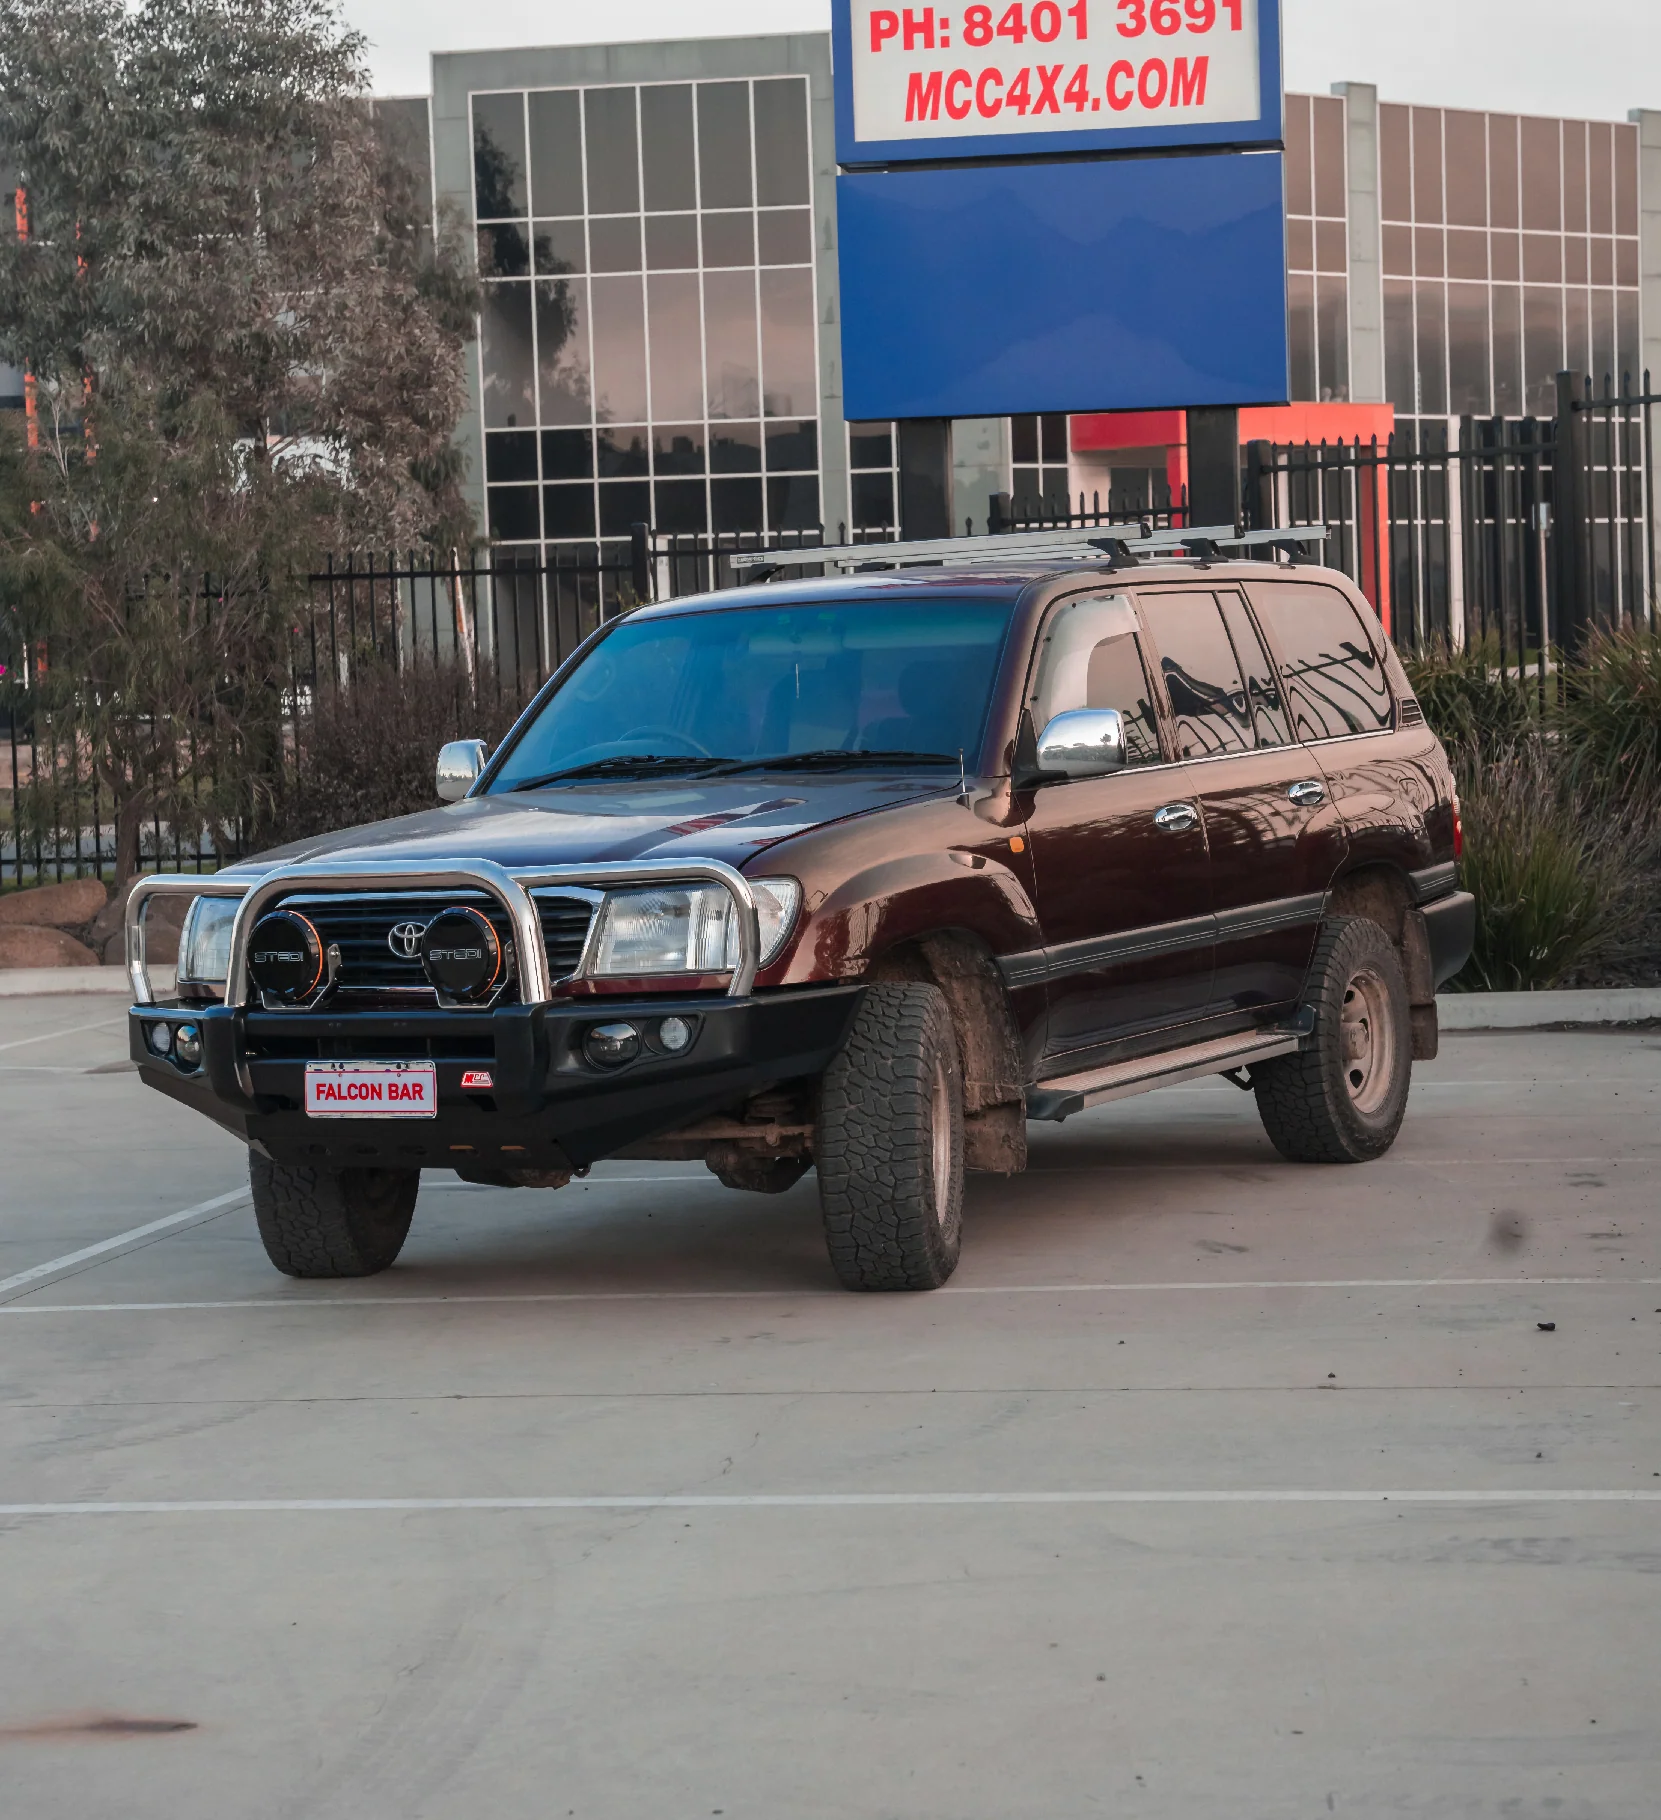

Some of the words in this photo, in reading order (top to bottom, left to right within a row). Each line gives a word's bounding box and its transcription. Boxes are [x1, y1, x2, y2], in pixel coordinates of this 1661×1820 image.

[869, 6, 951, 53] PH:
[962, 0, 1088, 48] 8401
[1115, 0, 1243, 38] 3691
[904, 55, 1210, 123] MCC4X4.COM
[255, 951, 304, 963] STEDI
[430, 948, 482, 961] STEDI
[316, 1083, 383, 1101] FALCON
[388, 1082, 424, 1100] BAR
